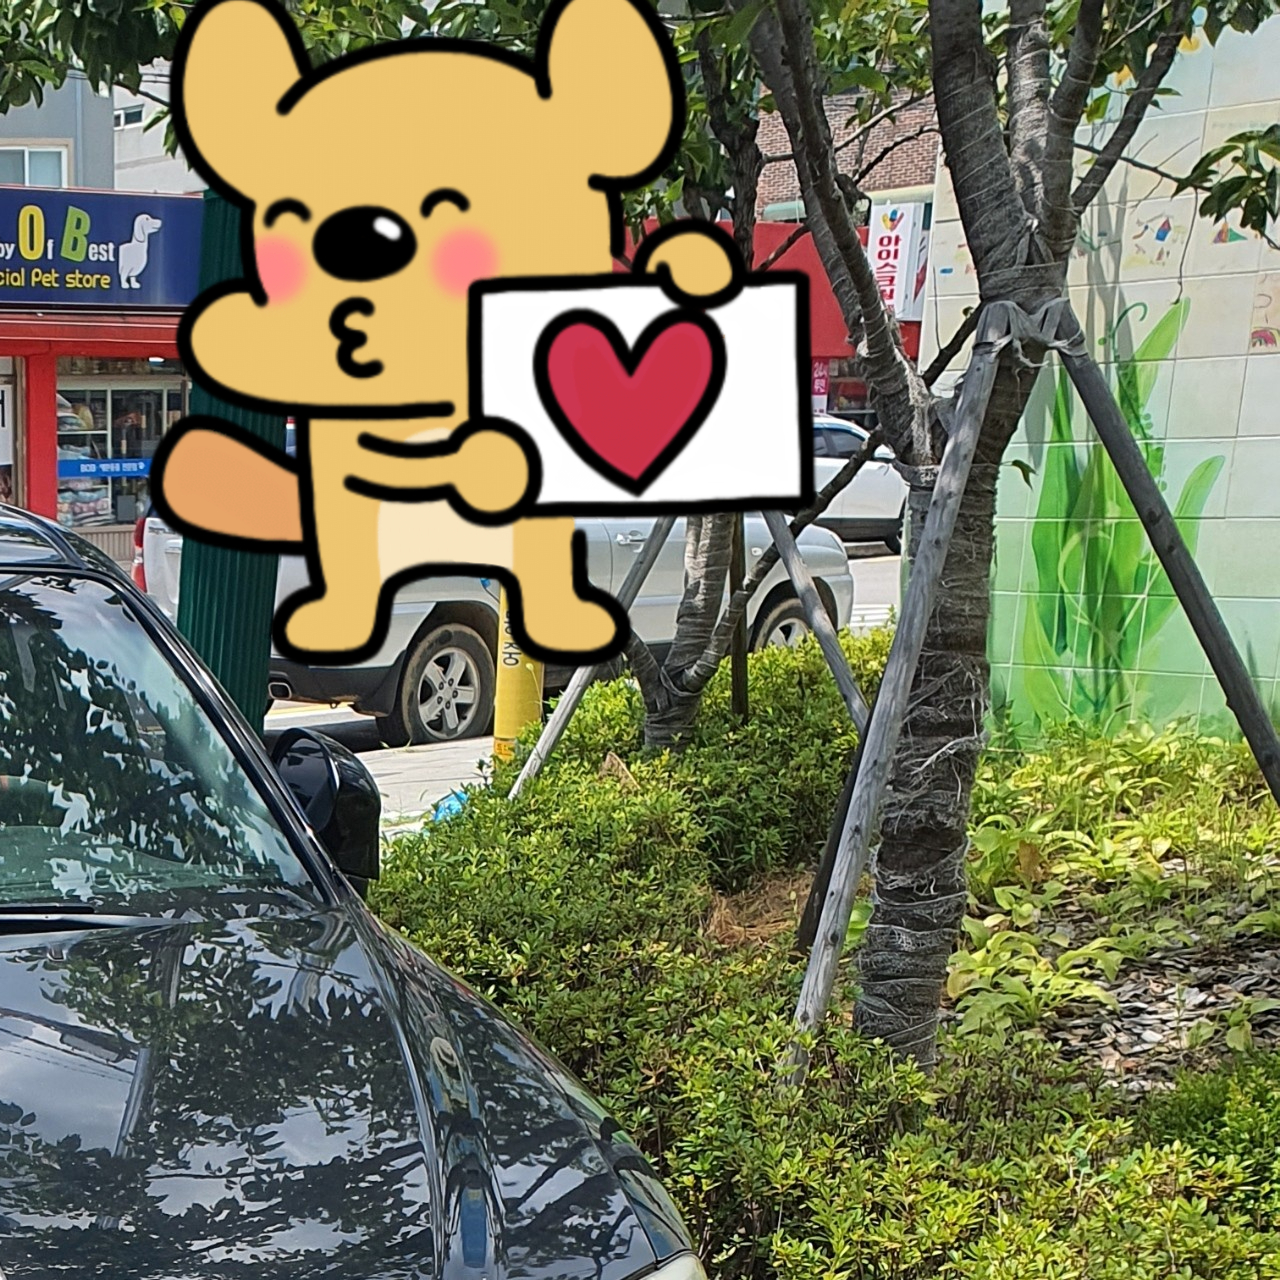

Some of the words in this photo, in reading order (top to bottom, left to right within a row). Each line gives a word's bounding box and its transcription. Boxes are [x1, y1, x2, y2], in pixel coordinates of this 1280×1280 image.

[19, 205, 54, 260] Of
[60, 205, 115, 262] Best
[31, 268, 60, 287] Pet
[65, 269, 111, 288] store
